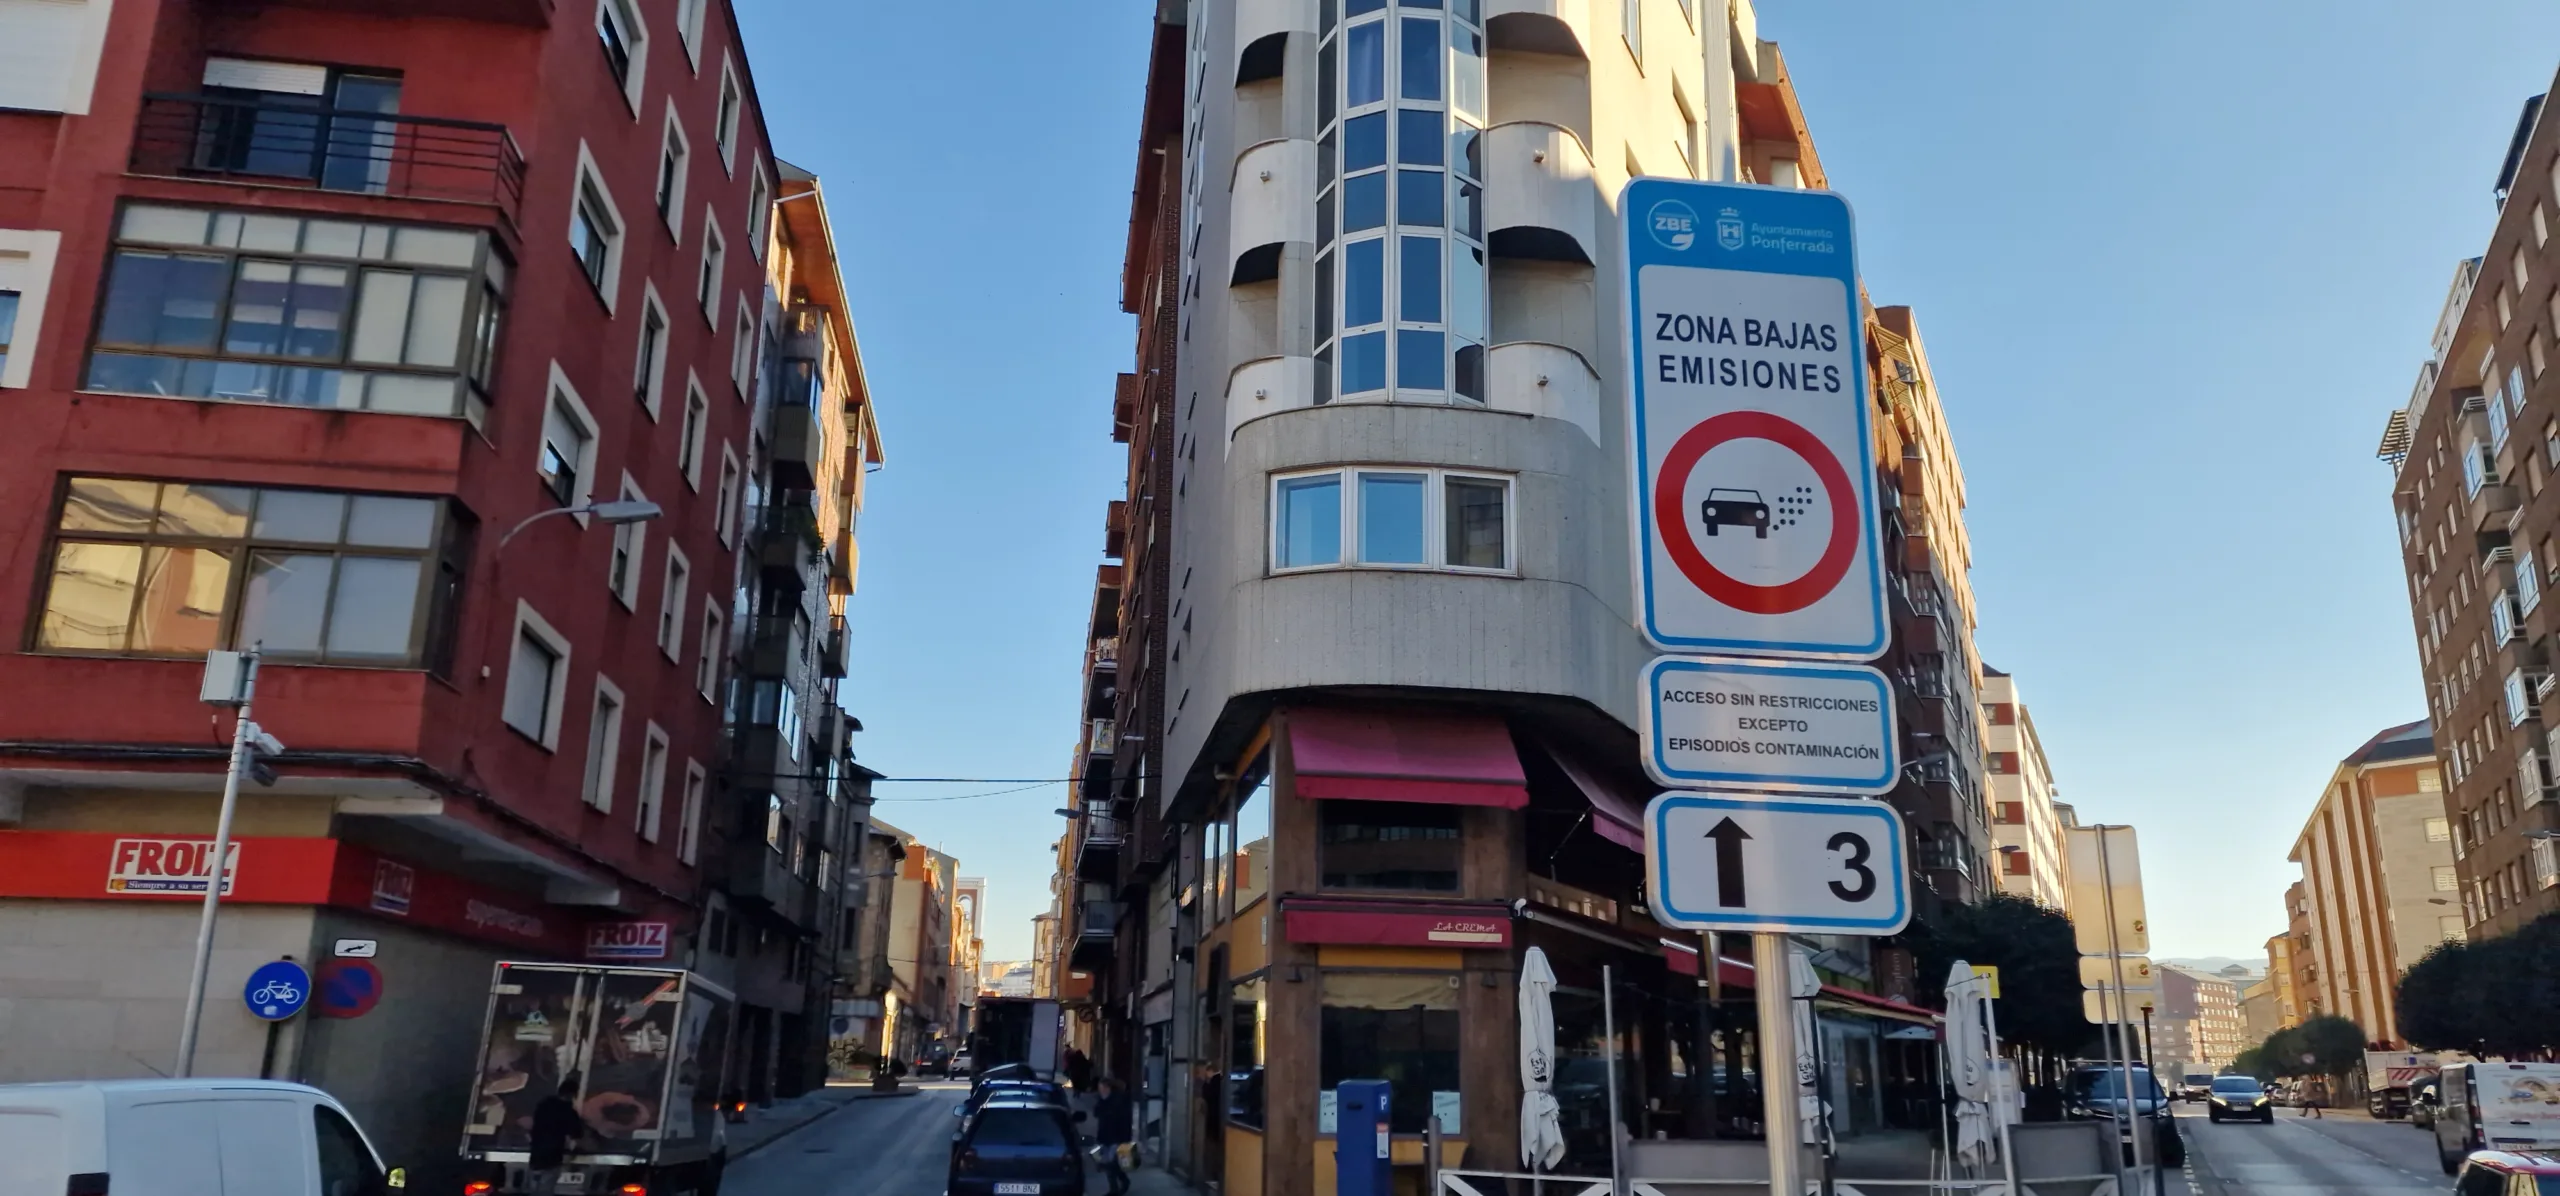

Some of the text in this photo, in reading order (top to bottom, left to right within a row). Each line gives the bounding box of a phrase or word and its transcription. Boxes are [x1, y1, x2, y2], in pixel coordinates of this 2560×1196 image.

[1655, 216, 1693, 232] ZBE
[1751, 222, 1834, 239] Ayuntamiento
[1751, 235, 1835, 254] Ponferrada
[1656, 312, 1838, 353] ZONA BAJAS
[1658, 354, 1842, 394] EMISIONES
[1663, 689, 1879, 713] ACCESO SIN RESTRICCIONES
[1738, 717, 1809, 733] EXCEPTO
[1668, 737, 1880, 760] EPISODIOS CONTAMINACIÓN
[1826, 831, 1878, 903] 3
[127, 880, 167, 891] Siempre
[590, 924, 664, 946] FROIZ
[1433, 922, 1497, 932] LA CREMA
